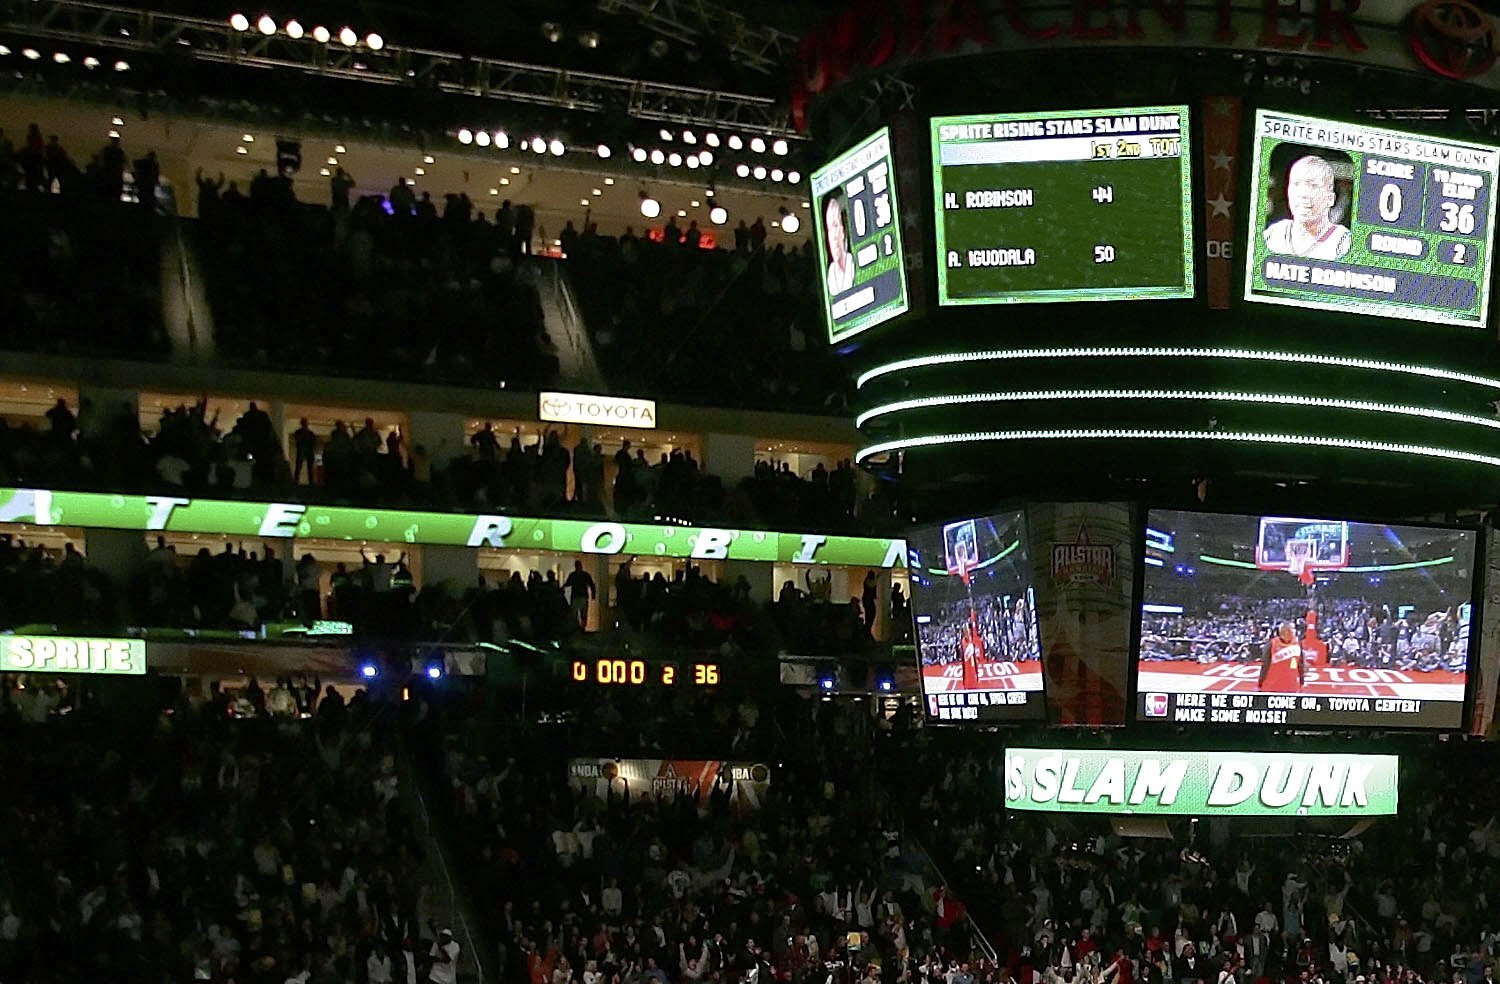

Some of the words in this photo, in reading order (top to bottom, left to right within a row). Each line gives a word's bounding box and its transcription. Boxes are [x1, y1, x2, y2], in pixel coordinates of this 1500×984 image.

[939, 124, 992, 141] SPRITE
[994, 121, 1044, 138] RISING
[1046, 118, 1093, 135] STARS
[1095, 116, 1137, 133] SLAM
[1139, 115, 1180, 131] DUNK
[1263, 120, 1313, 141] SPRITE
[1317, 129, 1365, 149] RISING
[1368, 137, 1411, 155] STARS
[1415, 144, 1450, 161] SLAM
[1366, 159, 1415, 180] SCORE
[965, 188, 1034, 208] ROBINSON
[1092, 186, 1113, 203] 44
[1378, 183, 1403, 222] 0
[1439, 201, 1475, 235] 36
[968, 248, 1035, 267] IGUODALA
[1094, 245, 1115, 263] 50
[1452, 243, 1466, 264] 2
[1265, 261, 1310, 281] NATE
[1311, 267, 1397, 293] ROBINSON
[576, 402, 654, 421] TOYOTA
[11, 638, 132, 672] SPRITE
[696, 664, 718, 684] 36
[1176, 693, 1206, 708] HERE
[1211, 694, 1227, 708] WE
[1233, 695, 1253, 709] GO!
[1267, 696, 1296, 709] COME
[1328, 698, 1370, 712] TOYOTA
[1375, 699, 1422, 713] CENTER!
[1175, 708, 1205, 722] MAKE
[1211, 709, 1240, 723] SOME
[1245, 710, 1287, 724] NOISE!
[1030, 756, 1189, 805] SLAM
[1207, 759, 1374, 808] DUNK
